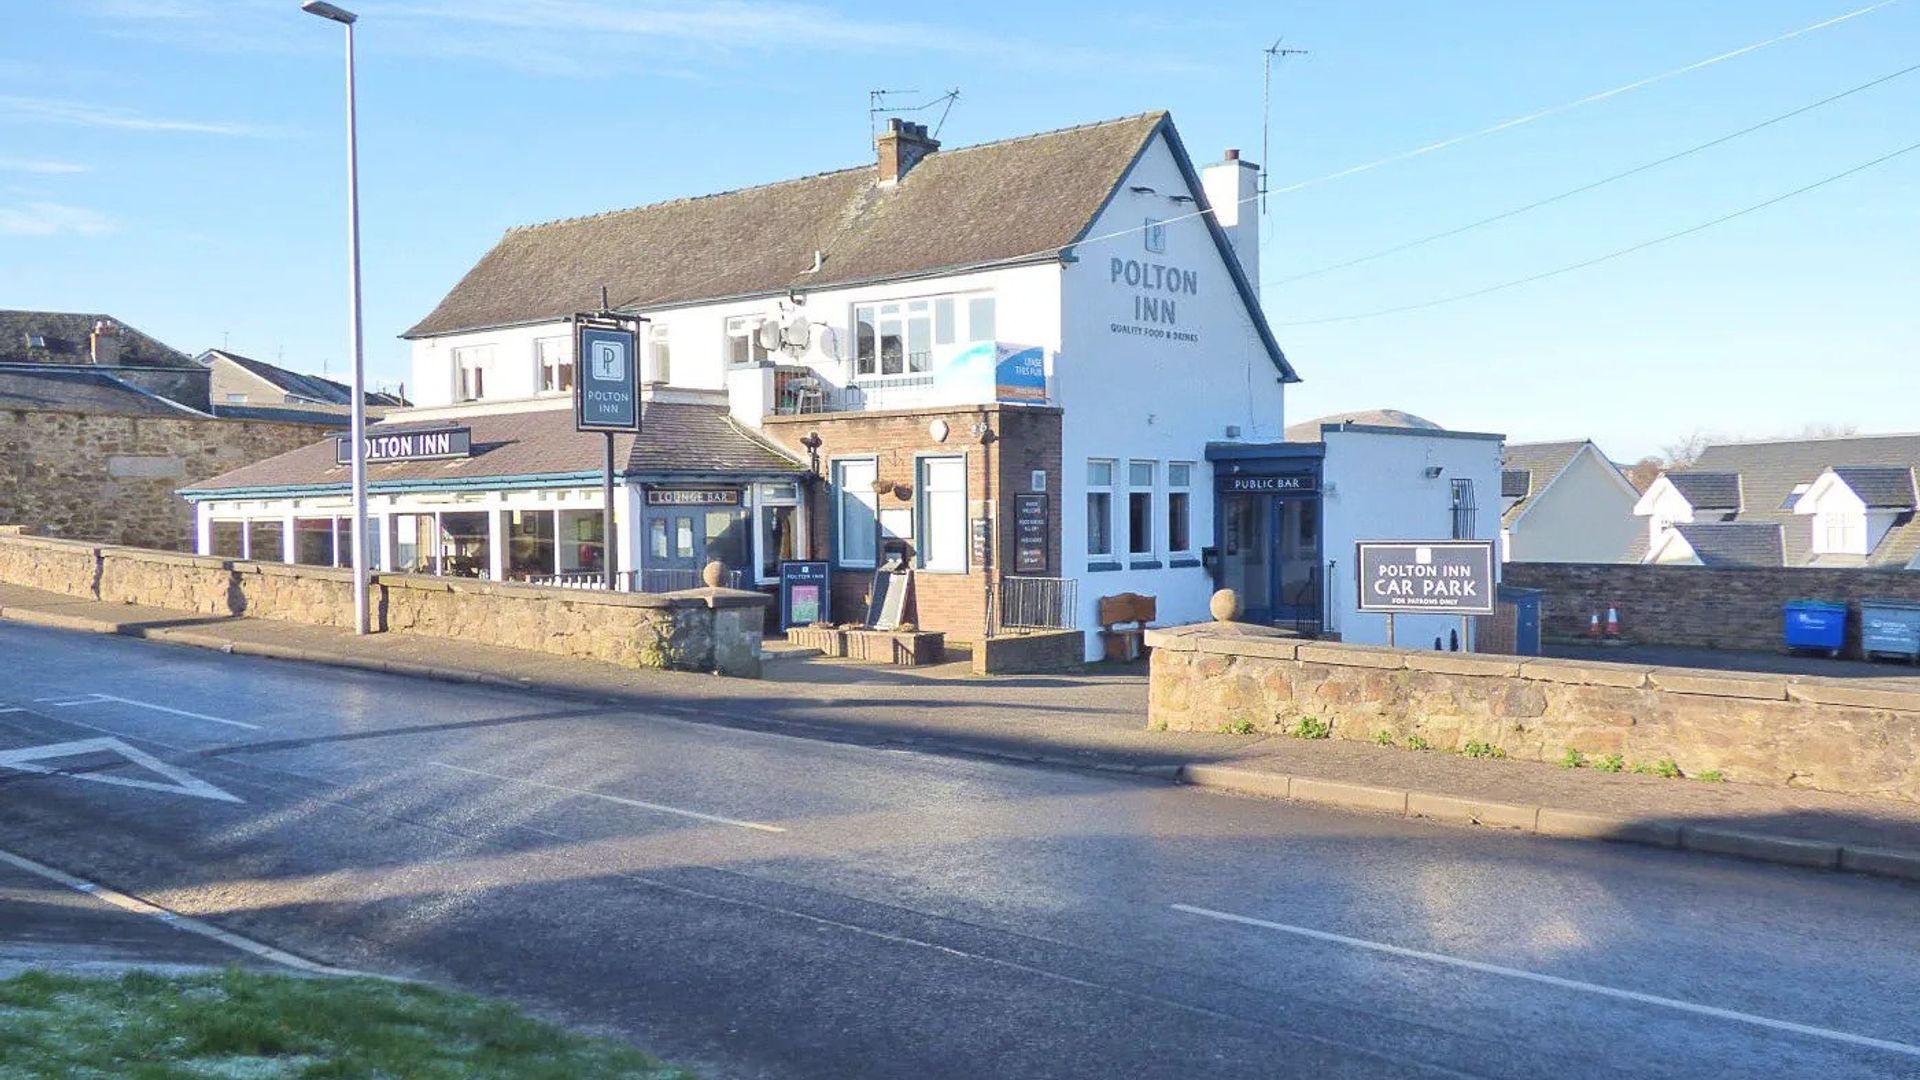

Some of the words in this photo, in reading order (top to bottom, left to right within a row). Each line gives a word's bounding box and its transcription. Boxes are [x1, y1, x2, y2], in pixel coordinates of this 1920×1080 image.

[1110, 257, 1197, 295] POLTON
[1135, 295, 1176, 324] INN
[1110, 322, 1142, 335] QUALITY
[1143, 327, 1164, 339] FOOD
[1173, 331, 1199, 342] DRINKS
[588, 390, 628, 401] POLTON
[599, 403, 618, 413] INN
[364, 435, 413, 459] OLTON
[419, 432, 450, 455] INN
[1235, 479, 1273, 489] PUBLIC
[1278, 478, 1300, 488] BAR
[659, 491, 704, 502] LOUNGE
[707, 491, 728, 502] BAR
[1379, 564, 1437, 577] POLTON
[1443, 565, 1471, 577] INN
[1374, 579, 1414, 595] CAR
[1423, 579, 1477, 596] PARK
[1392, 597, 1405, 605] FOR
